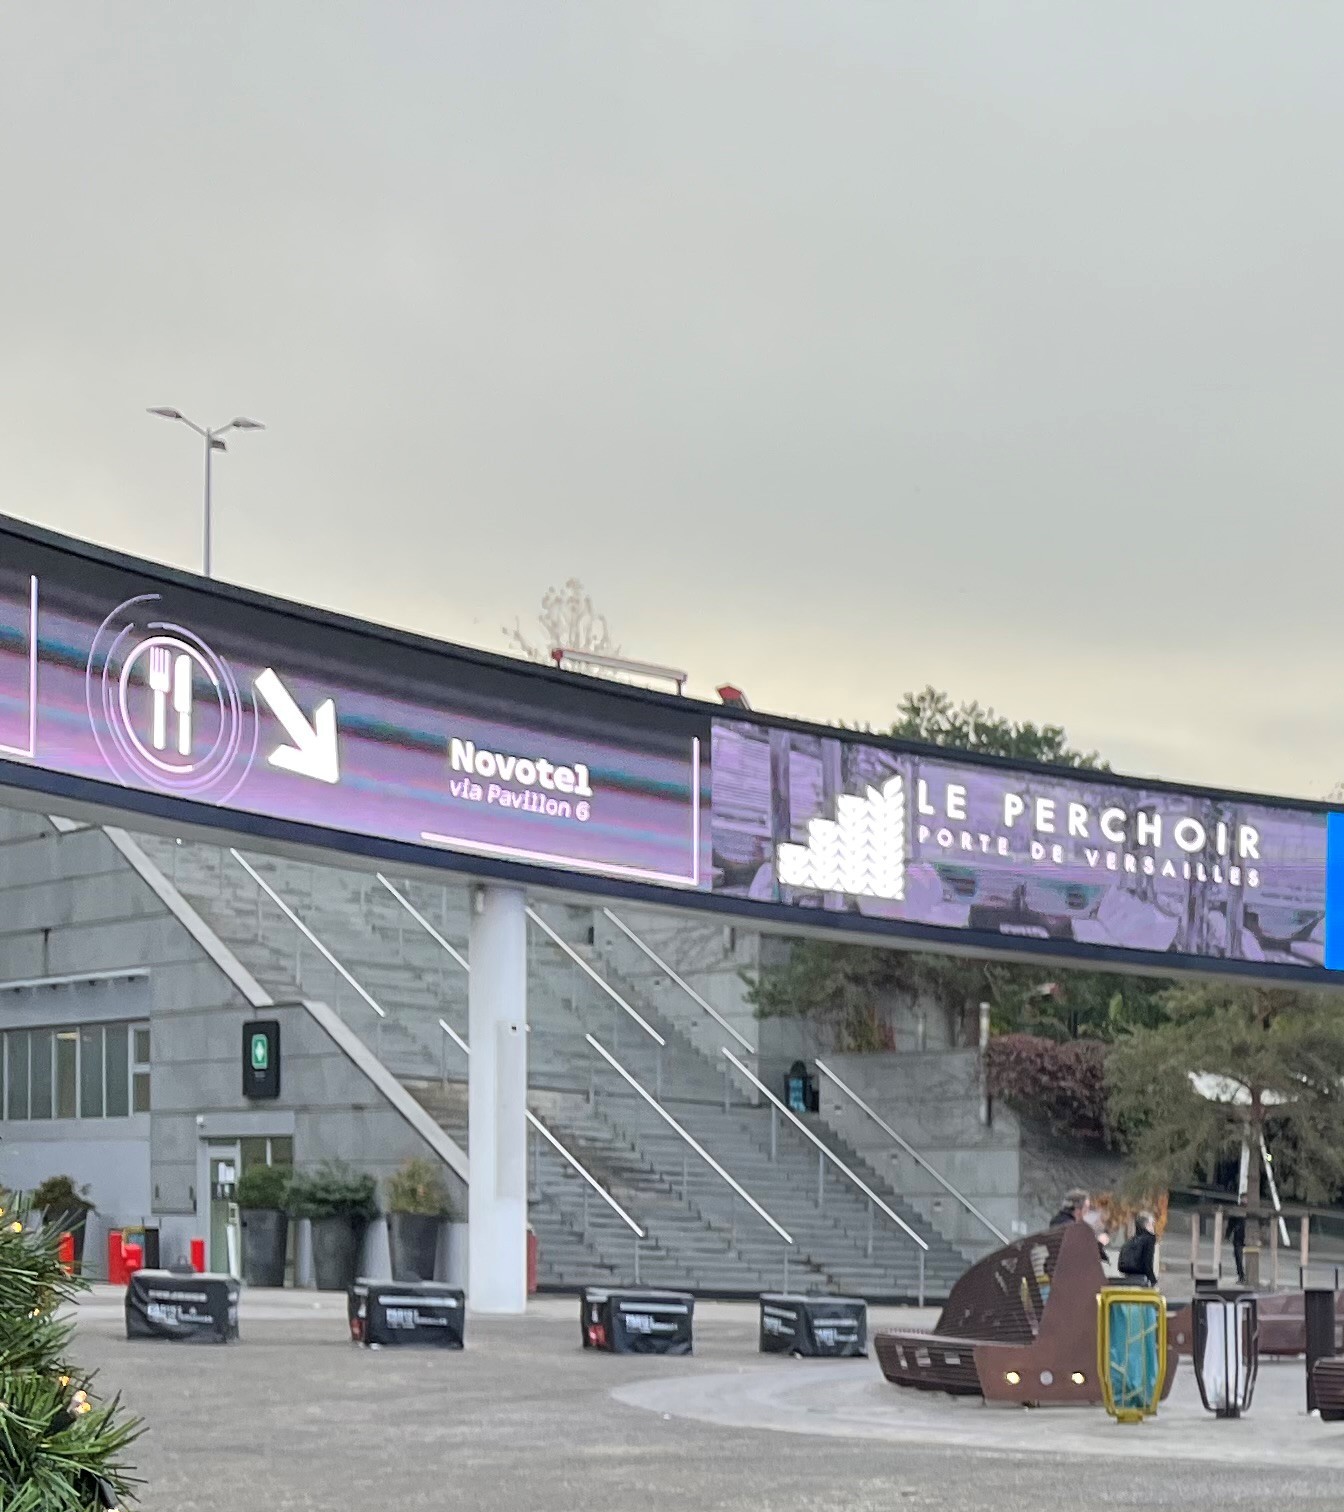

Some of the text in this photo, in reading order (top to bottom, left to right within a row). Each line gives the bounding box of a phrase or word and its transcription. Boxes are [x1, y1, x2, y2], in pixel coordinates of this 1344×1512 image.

[450, 737, 593, 797] Novotel
[450, 777, 483, 801] via
[575, 801, 591, 821] 6
[918, 778, 1260, 859] LE PERCHOIR
[919, 825, 1260, 888] PORTE DE VERSAILLES
